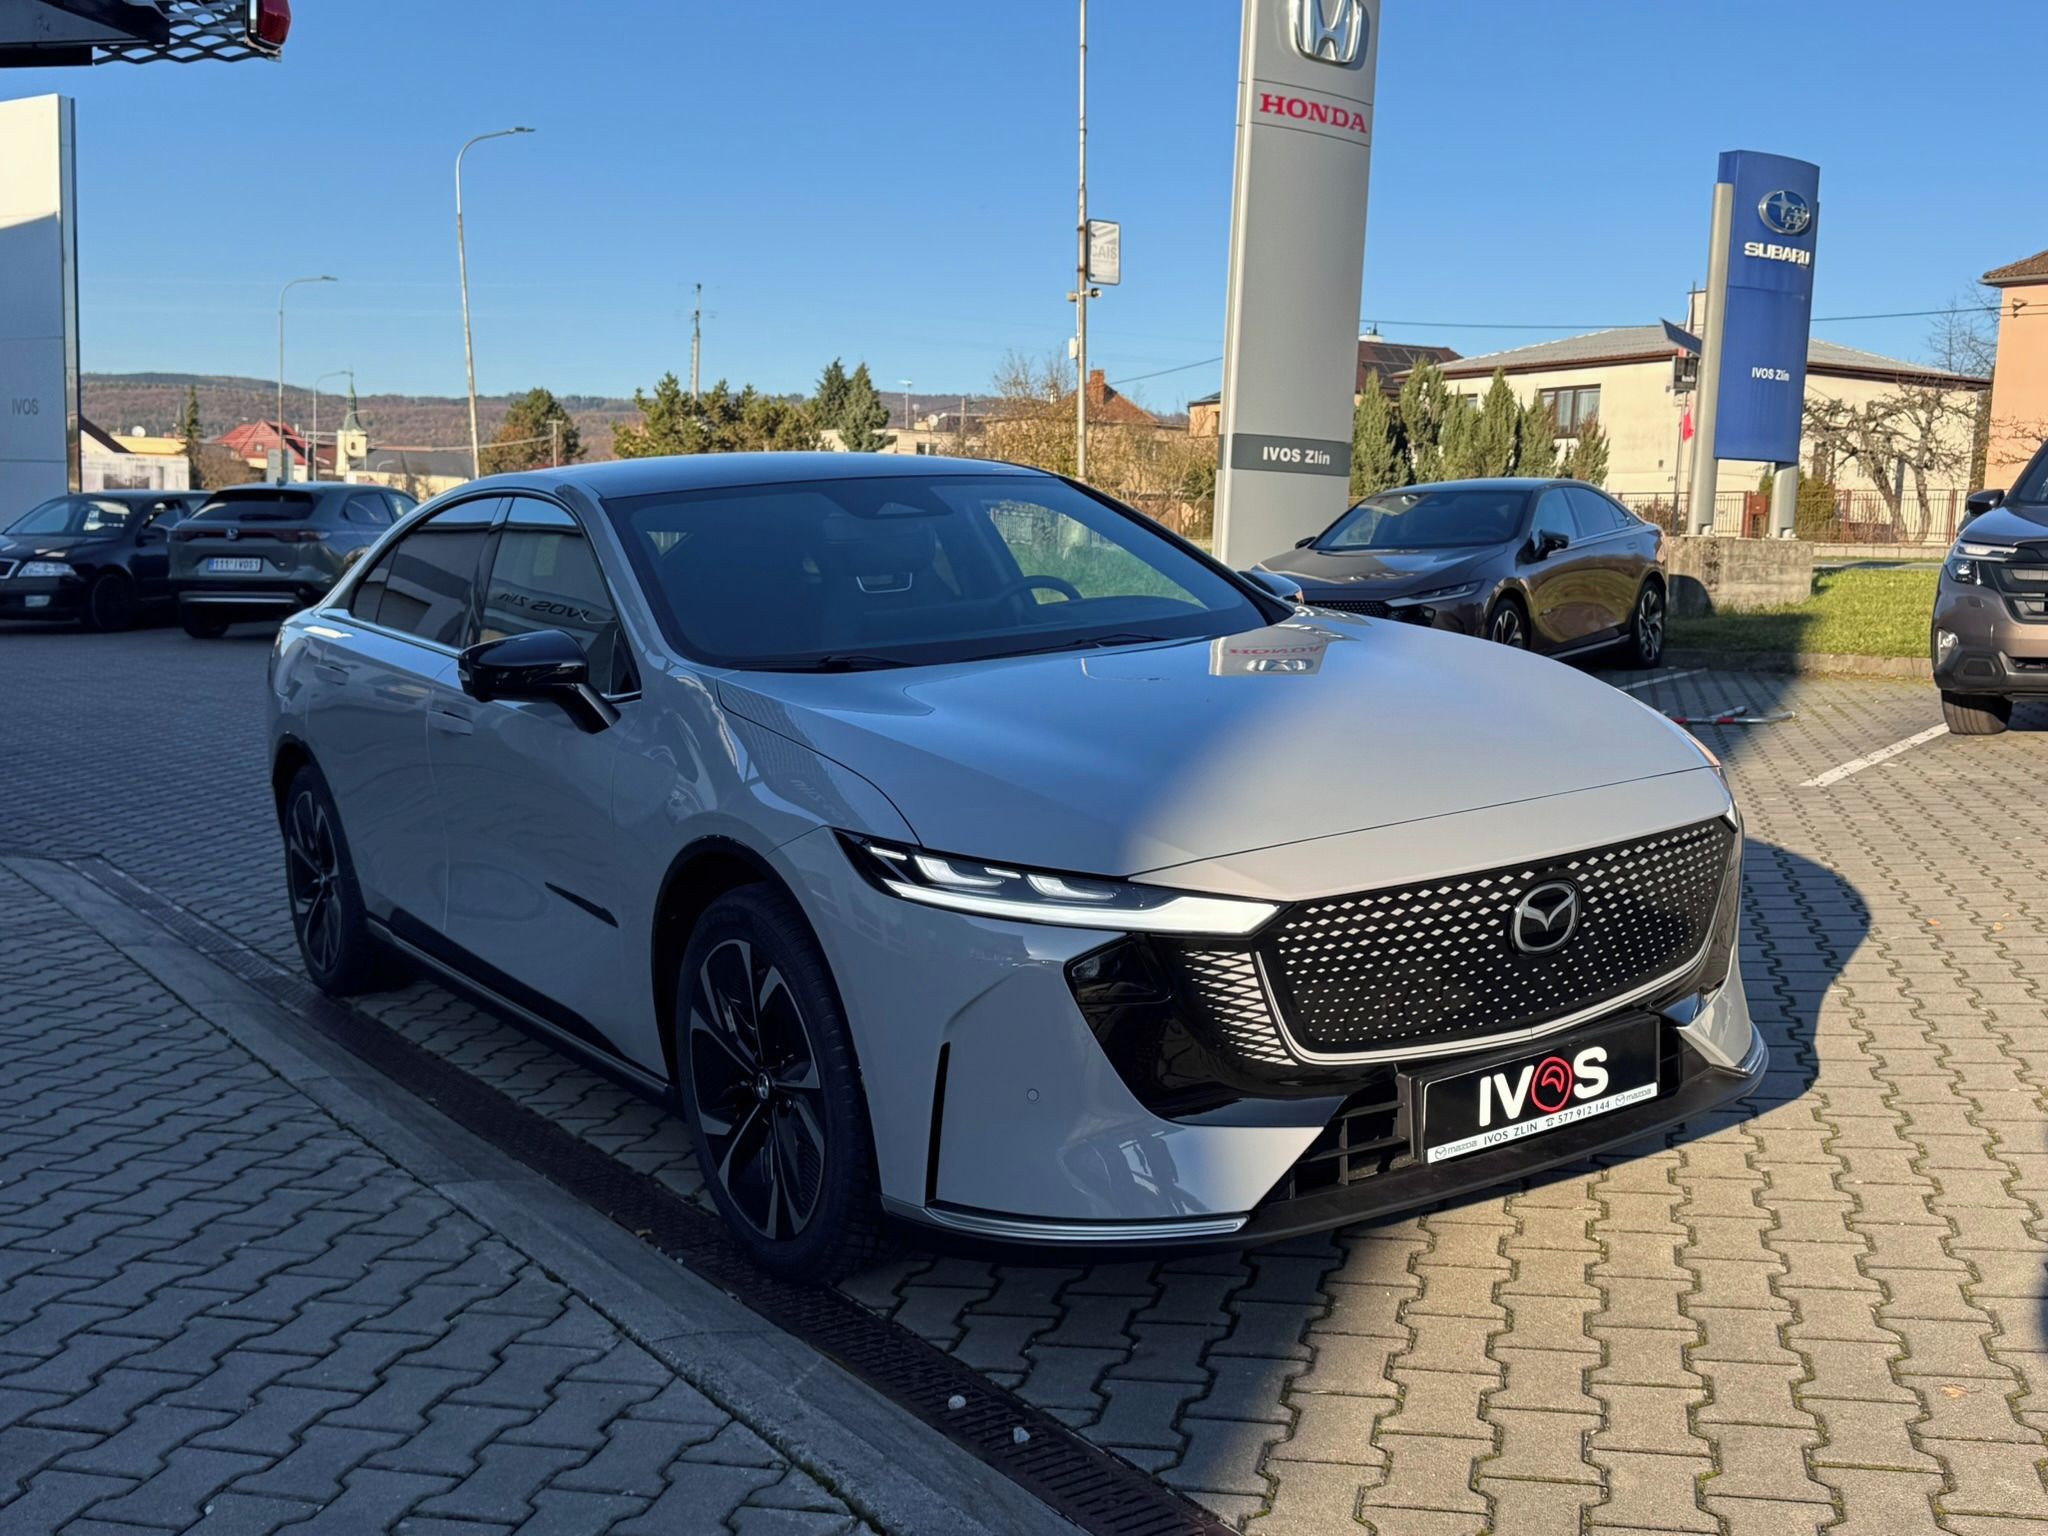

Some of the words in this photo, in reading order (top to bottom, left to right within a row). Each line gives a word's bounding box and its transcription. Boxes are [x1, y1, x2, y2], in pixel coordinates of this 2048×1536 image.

[1259, 92, 1368, 134] HONDA
[1744, 241, 1811, 266] SUBARU
[1751, 366, 1775, 380] IVOS
[11, 397, 39, 416] IVOS
[1262, 446, 1301, 463] IVOS
[1304, 449, 1330, 465] Zlín
[1479, 1046, 1609, 1127] IVOS
[1447, 1140, 1478, 1154] mazda
[1484, 1130, 1509, 1145] IVOS
[1558, 1111, 1574, 1124] 577
[1576, 1106, 1592, 1117] 912
[1596, 1100, 1610, 1111] 144
[1626, 1088, 1652, 1102] mazda
